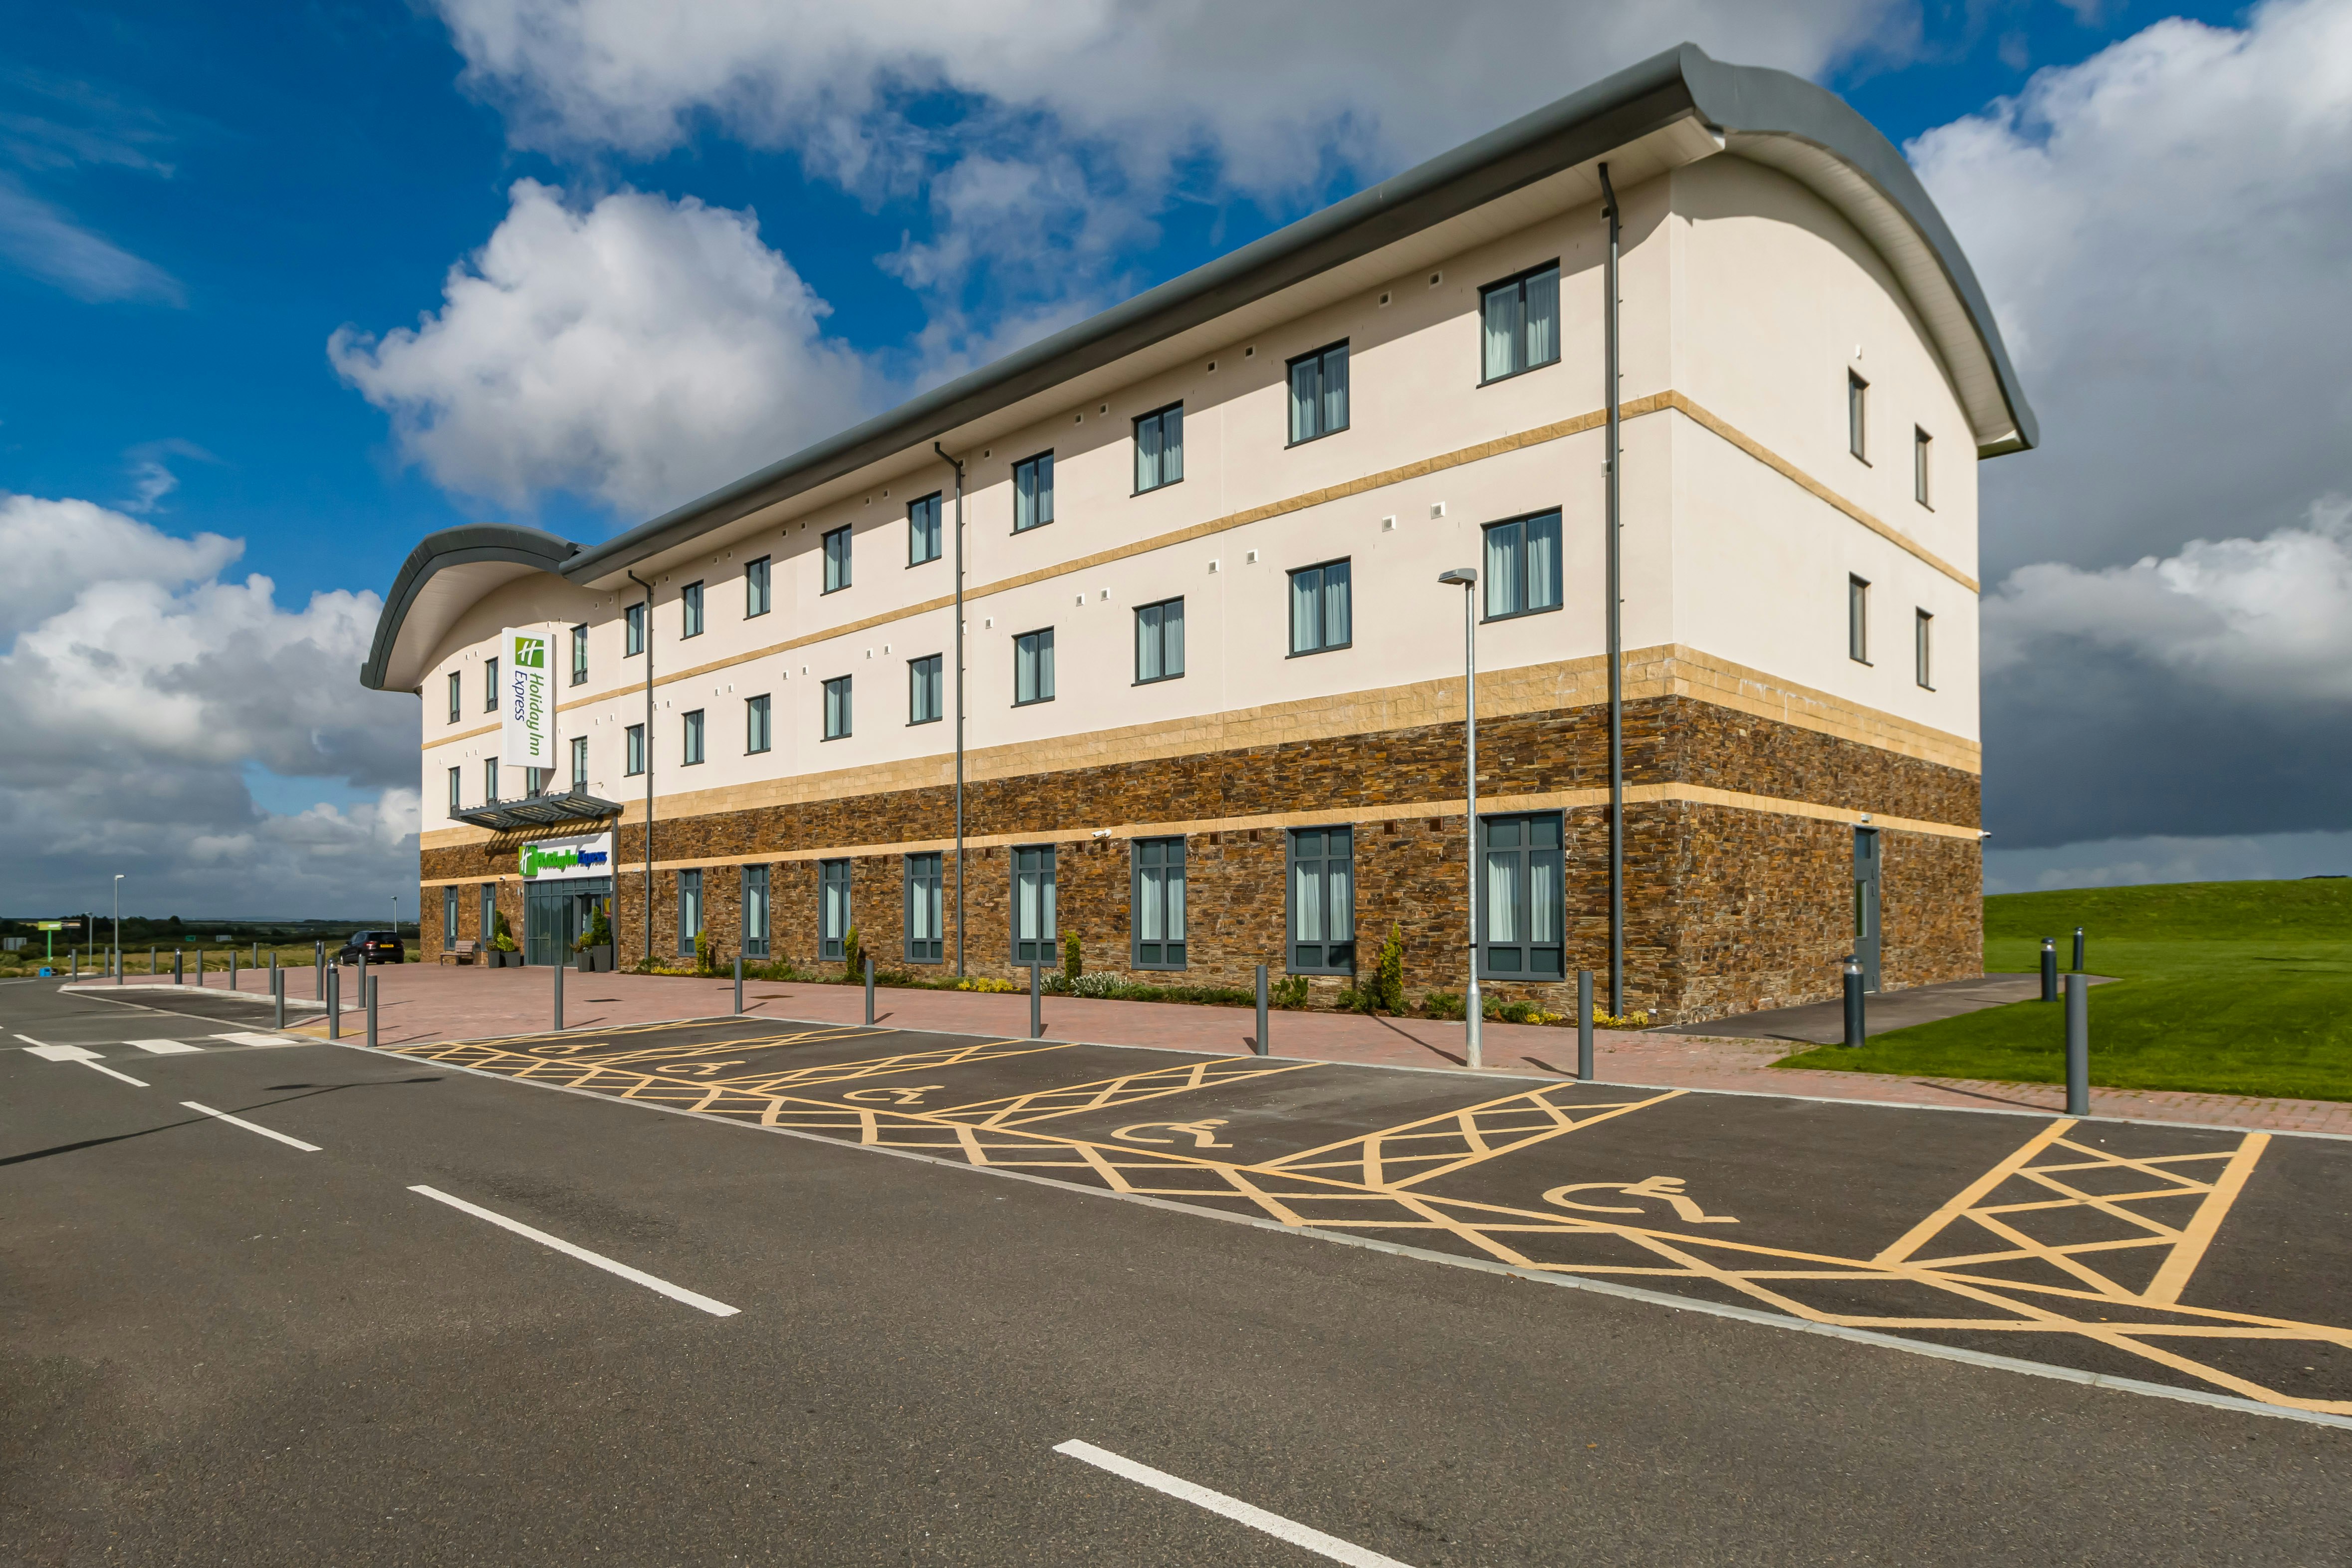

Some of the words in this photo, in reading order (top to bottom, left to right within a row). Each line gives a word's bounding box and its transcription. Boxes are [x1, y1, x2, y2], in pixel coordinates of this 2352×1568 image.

[512, 670, 527, 722] Express
[526, 672, 544, 731] Holiday
[529, 732, 544, 756] Inn
